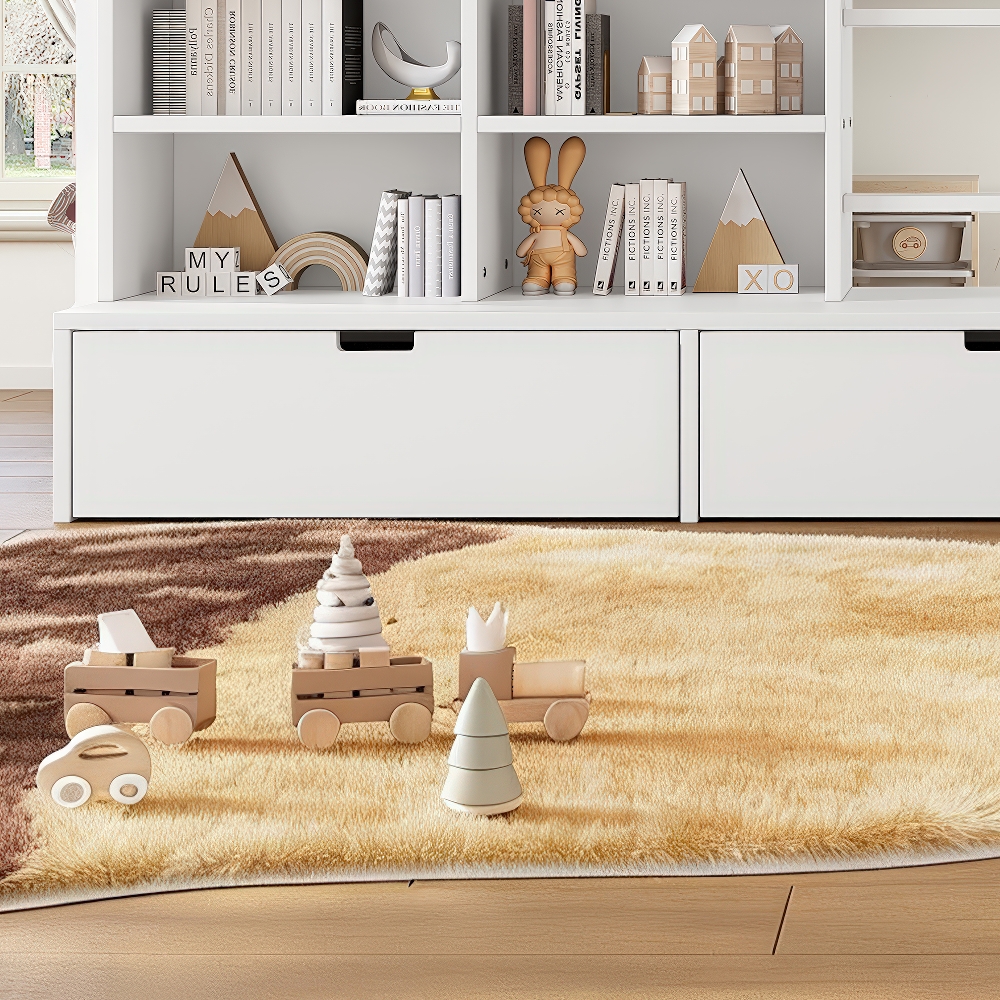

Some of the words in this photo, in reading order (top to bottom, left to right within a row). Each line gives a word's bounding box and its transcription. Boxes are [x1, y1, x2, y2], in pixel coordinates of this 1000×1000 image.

[602, 219, 615, 261] FICTIONS
[189, 252, 229, 268] MY
[162, 271, 280, 292] RULES
